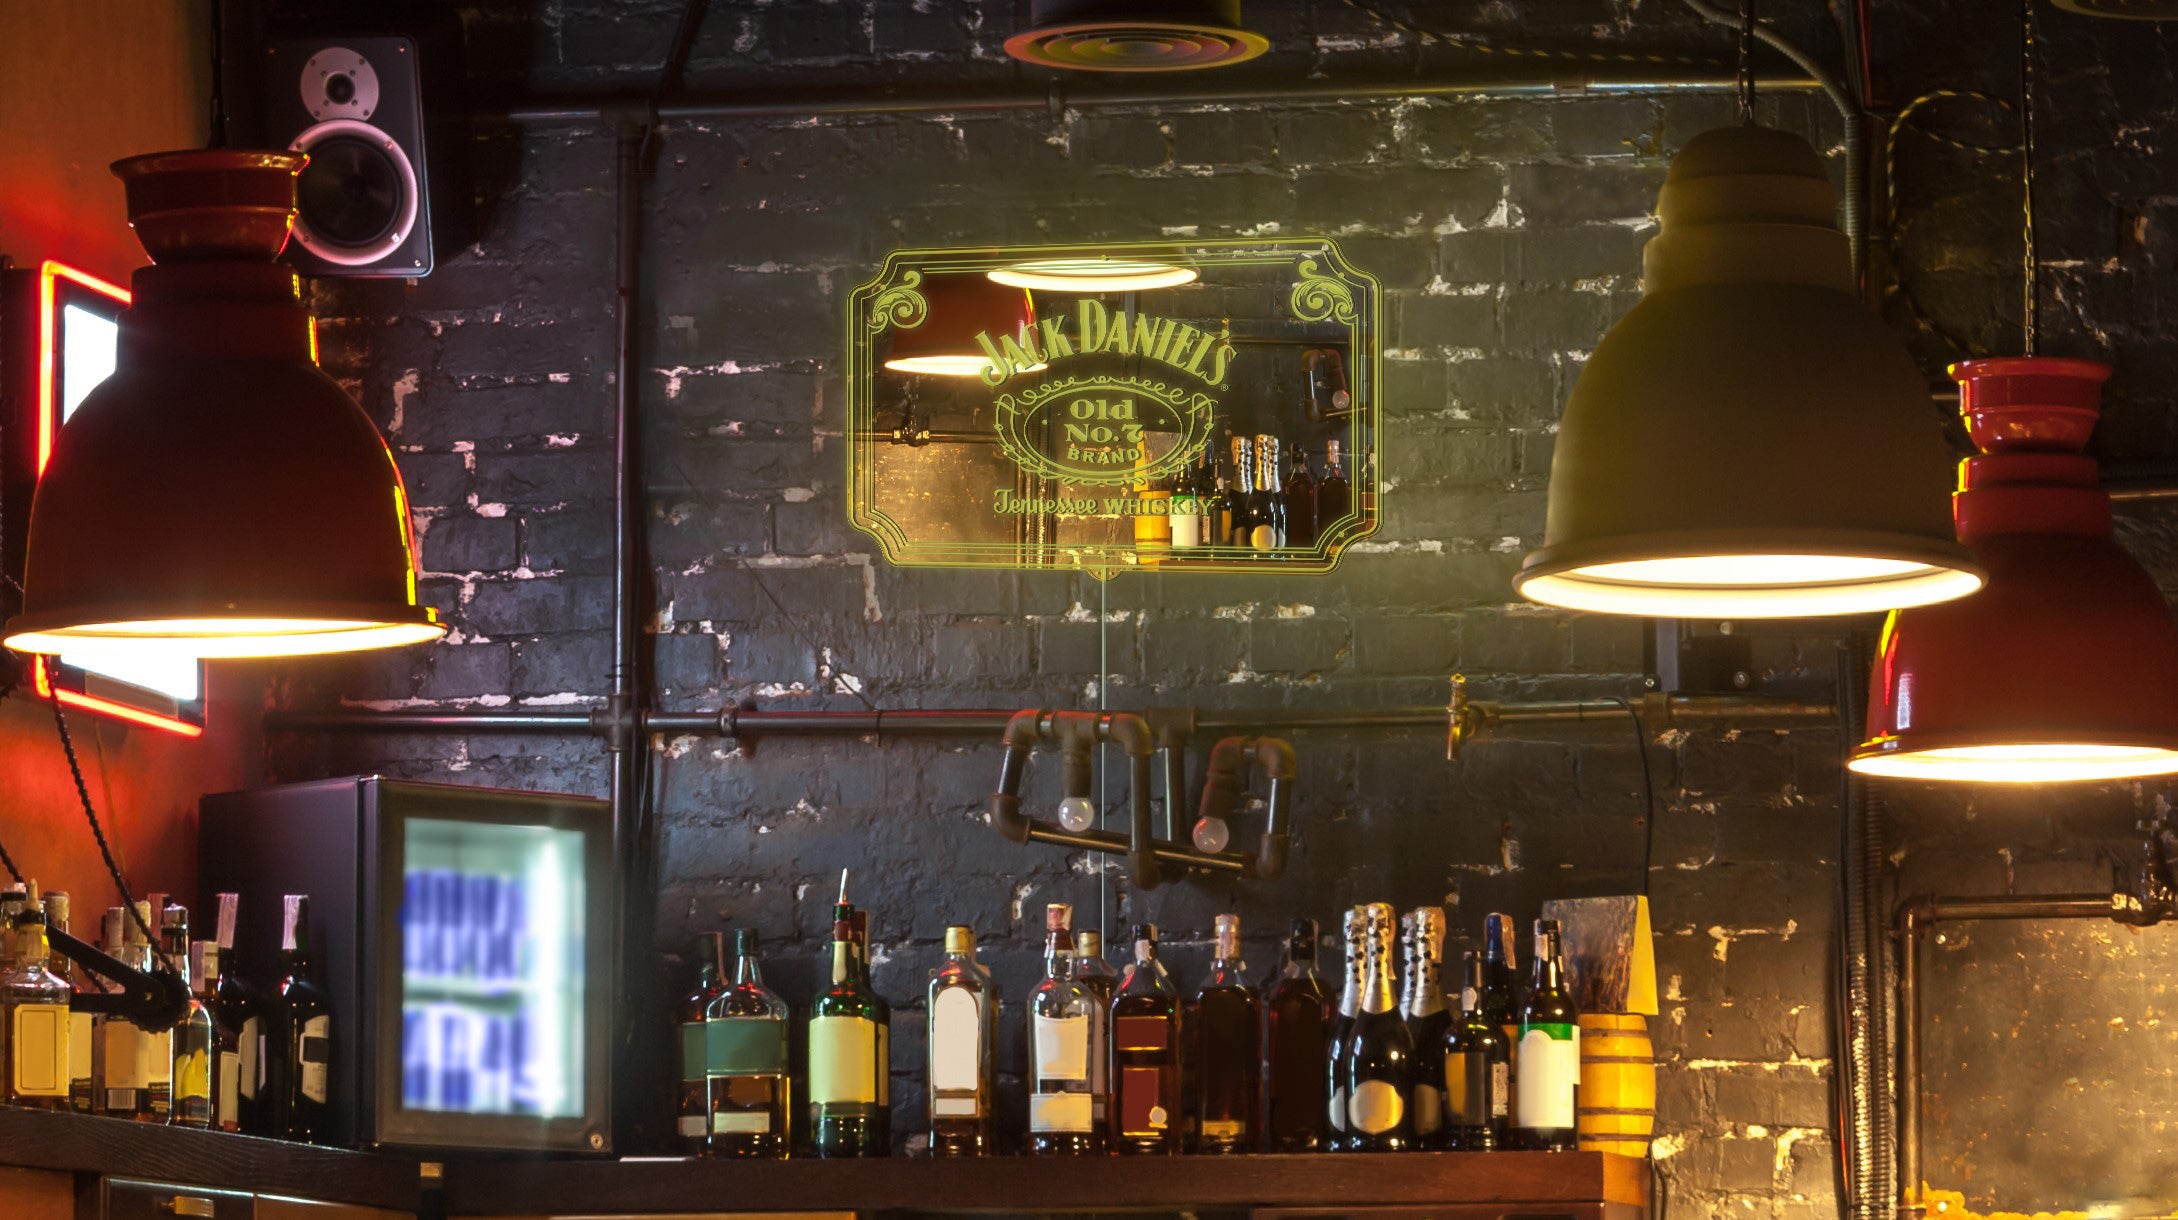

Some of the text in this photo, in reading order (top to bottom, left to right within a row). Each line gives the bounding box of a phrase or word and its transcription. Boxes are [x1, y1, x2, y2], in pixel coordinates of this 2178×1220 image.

[975, 315, 1074, 386] JACK
[1069, 399, 1135, 420] Old
[1067, 447, 1142, 464] BRAND
[993, 488, 1214, 516] Tennessee WHISKEY
